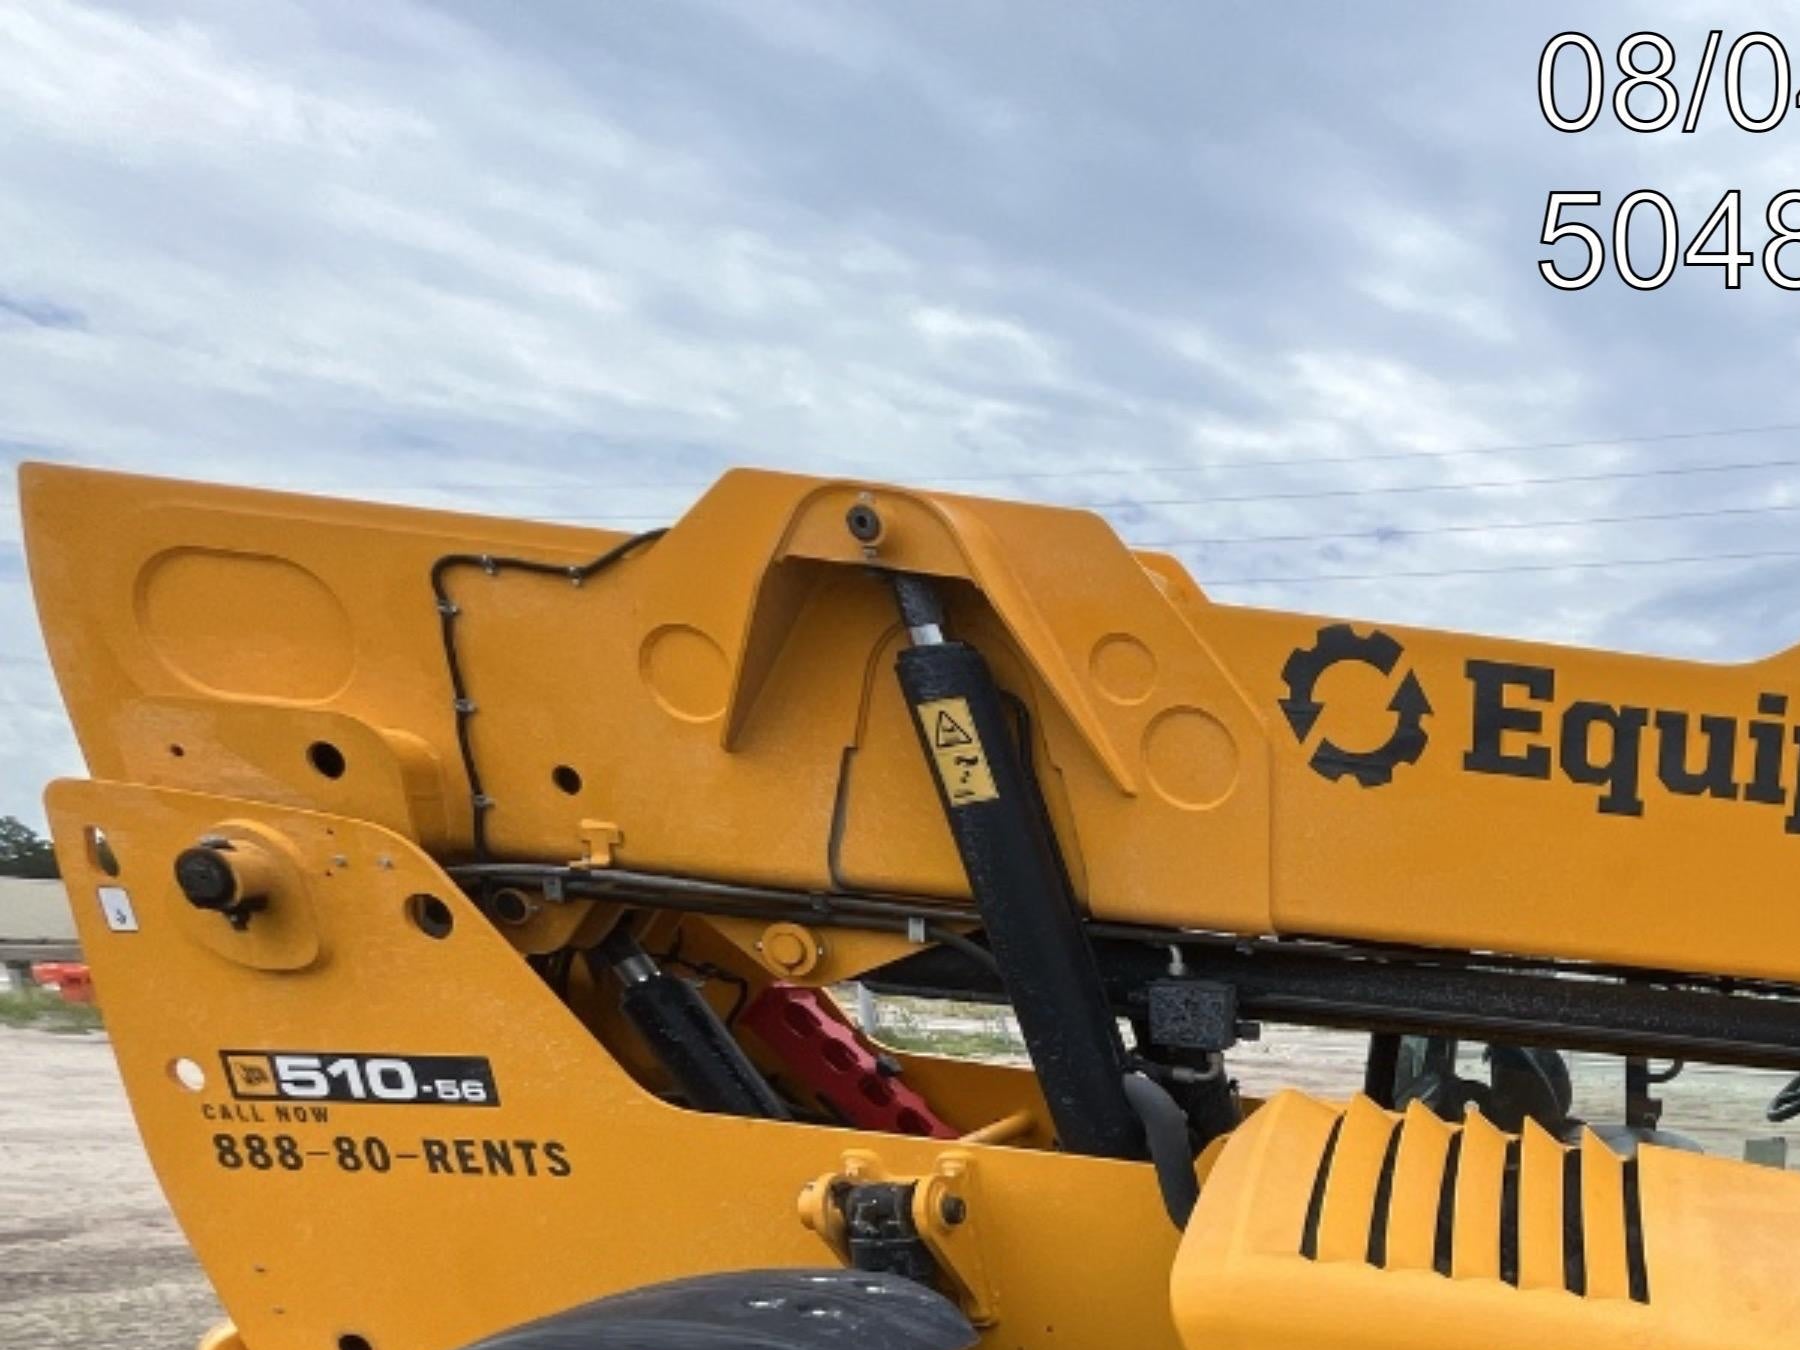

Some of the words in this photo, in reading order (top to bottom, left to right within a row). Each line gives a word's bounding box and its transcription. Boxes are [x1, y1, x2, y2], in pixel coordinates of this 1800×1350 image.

[201, 1103, 265, 1123] CALL
[275, 1104, 329, 1124] NOW
[212, 1132, 572, 1178] 888-80-RENTS
